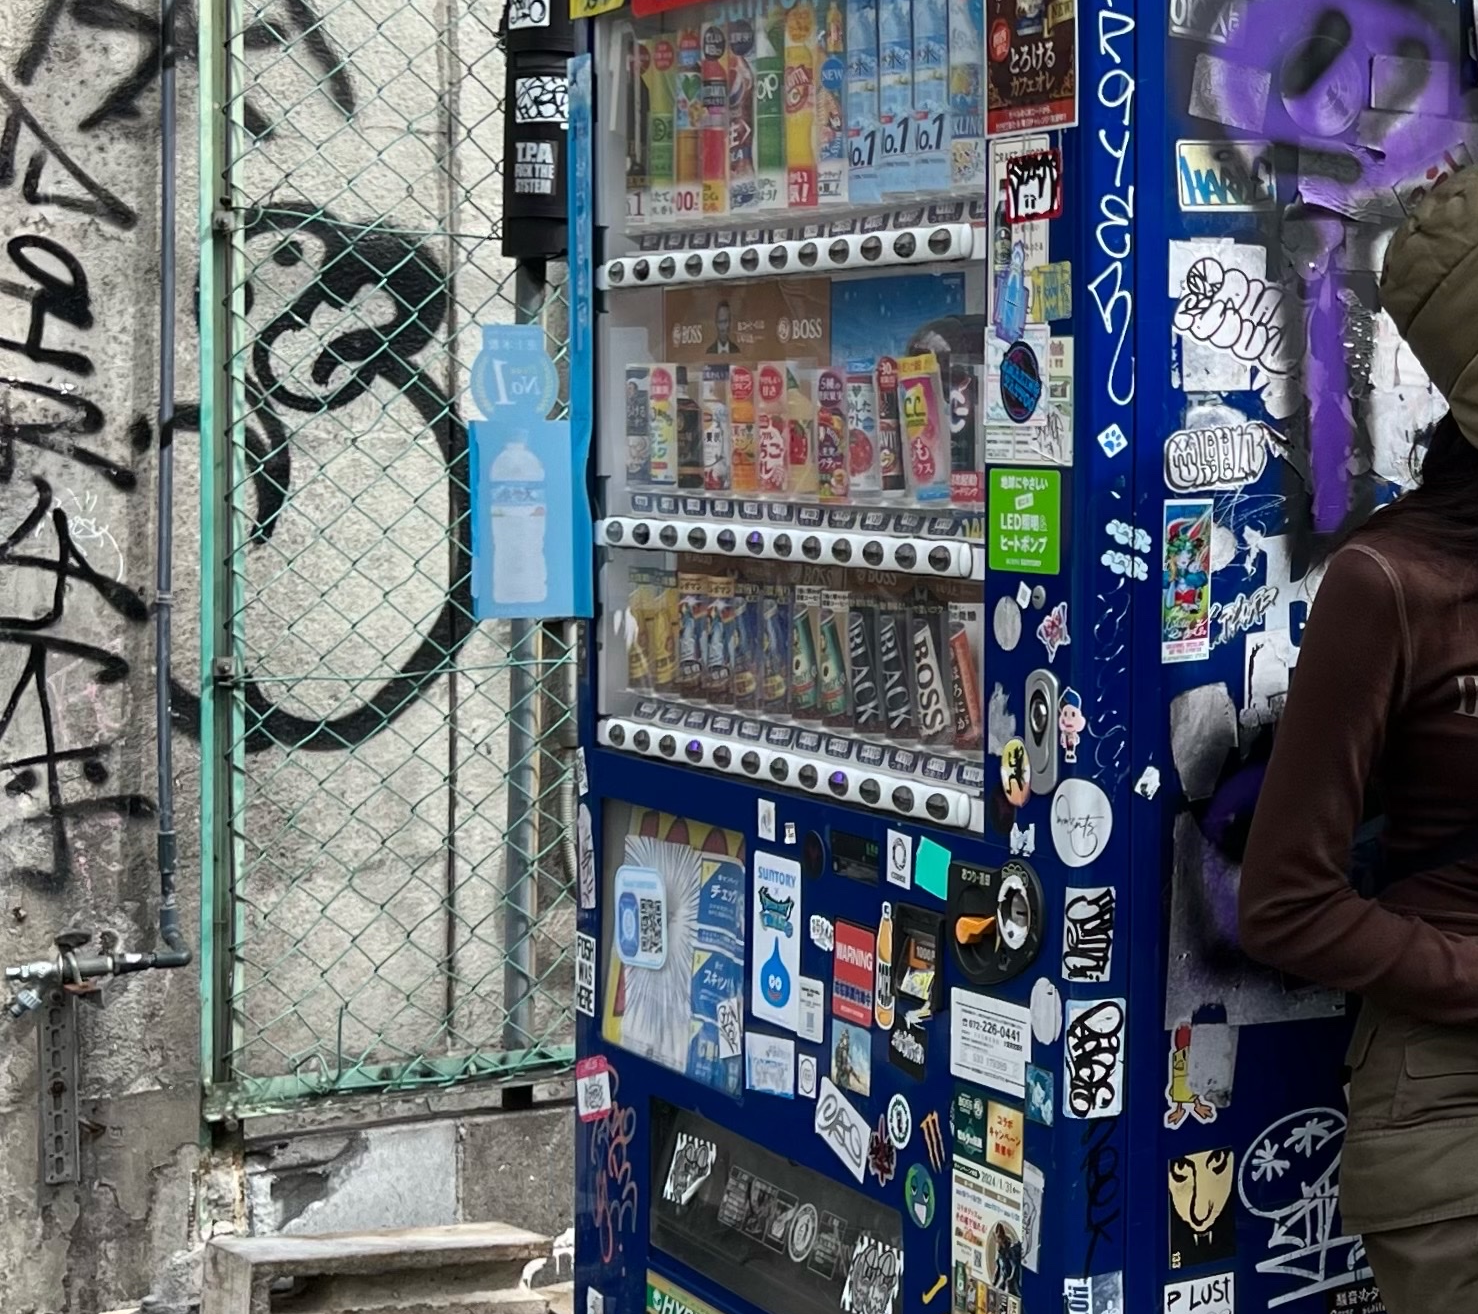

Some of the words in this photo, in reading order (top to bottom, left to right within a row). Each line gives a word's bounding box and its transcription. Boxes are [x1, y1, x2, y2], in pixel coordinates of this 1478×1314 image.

[1010, 41, 1056, 74] とろける
[821, 68, 844, 83] NEW
[1010, 71, 1056, 97] カフェオレ
[792, 318, 823, 339] BOSS
[1000, 534, 1048, 554] ヒートポンプ
[850, 627, 880, 724] BLACK
[881, 630, 913, 730] BLACK
[914, 638, 945, 734] BOSS
[757, 865, 797, 888] SUNTORY
[835, 942, 873, 972] WARNING
[989, 1126, 1021, 1147] キャンペーン
[1189, 1276, 1231, 1306] LUST
